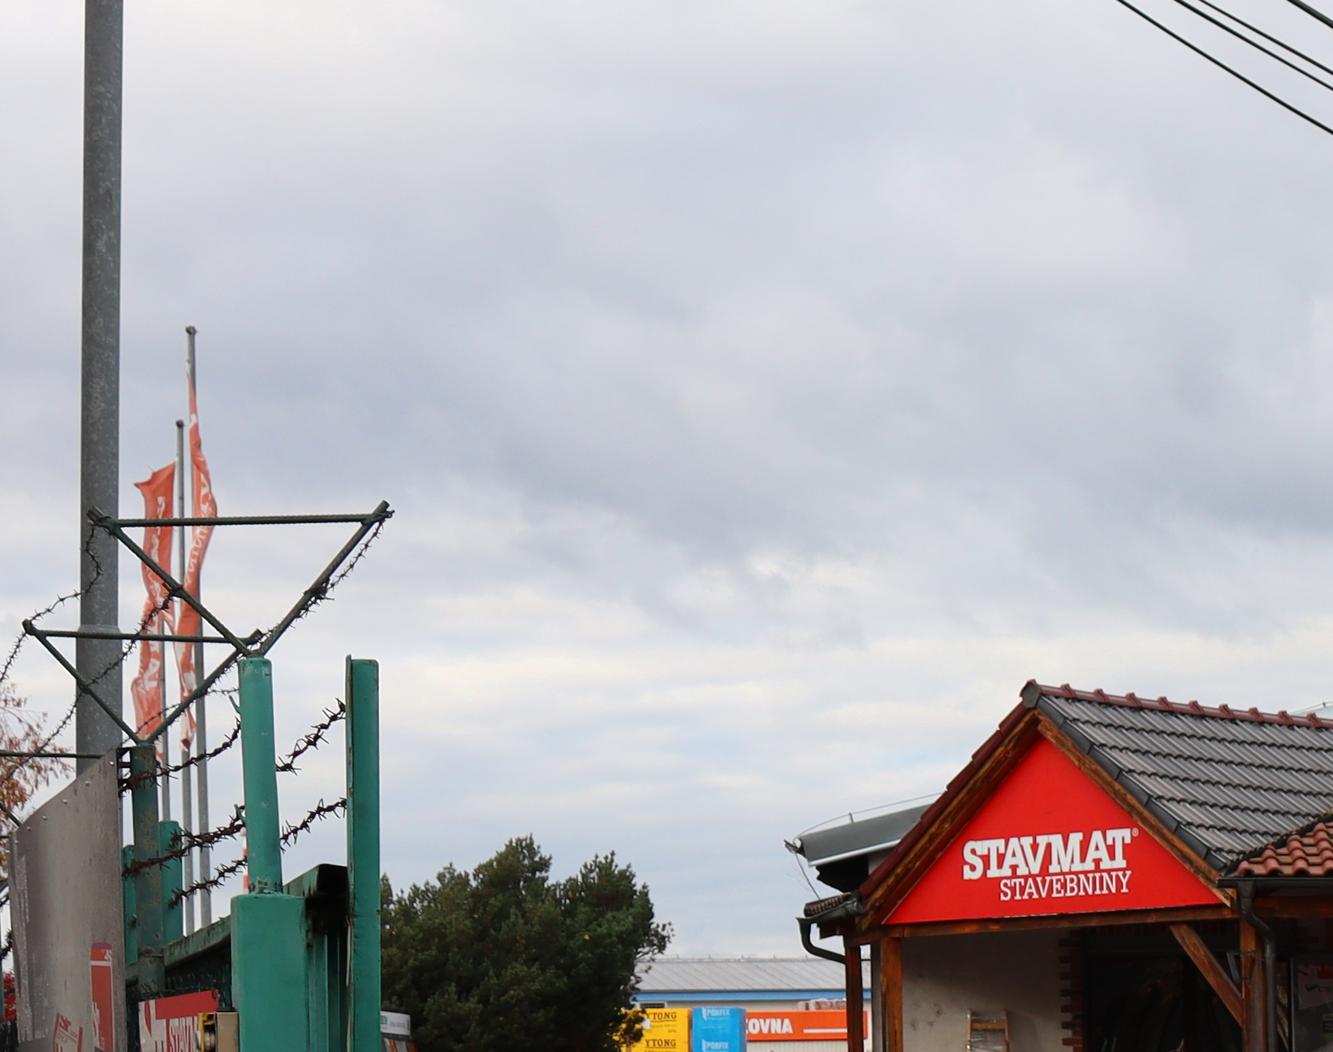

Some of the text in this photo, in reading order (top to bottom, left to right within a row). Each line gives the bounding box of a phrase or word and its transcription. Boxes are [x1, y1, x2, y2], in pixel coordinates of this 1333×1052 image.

[962, 827, 1132, 880] STAVMAT
[1000, 870, 1132, 901] STAVEBNINY
[644, 1039, 677, 1048] YTONG
